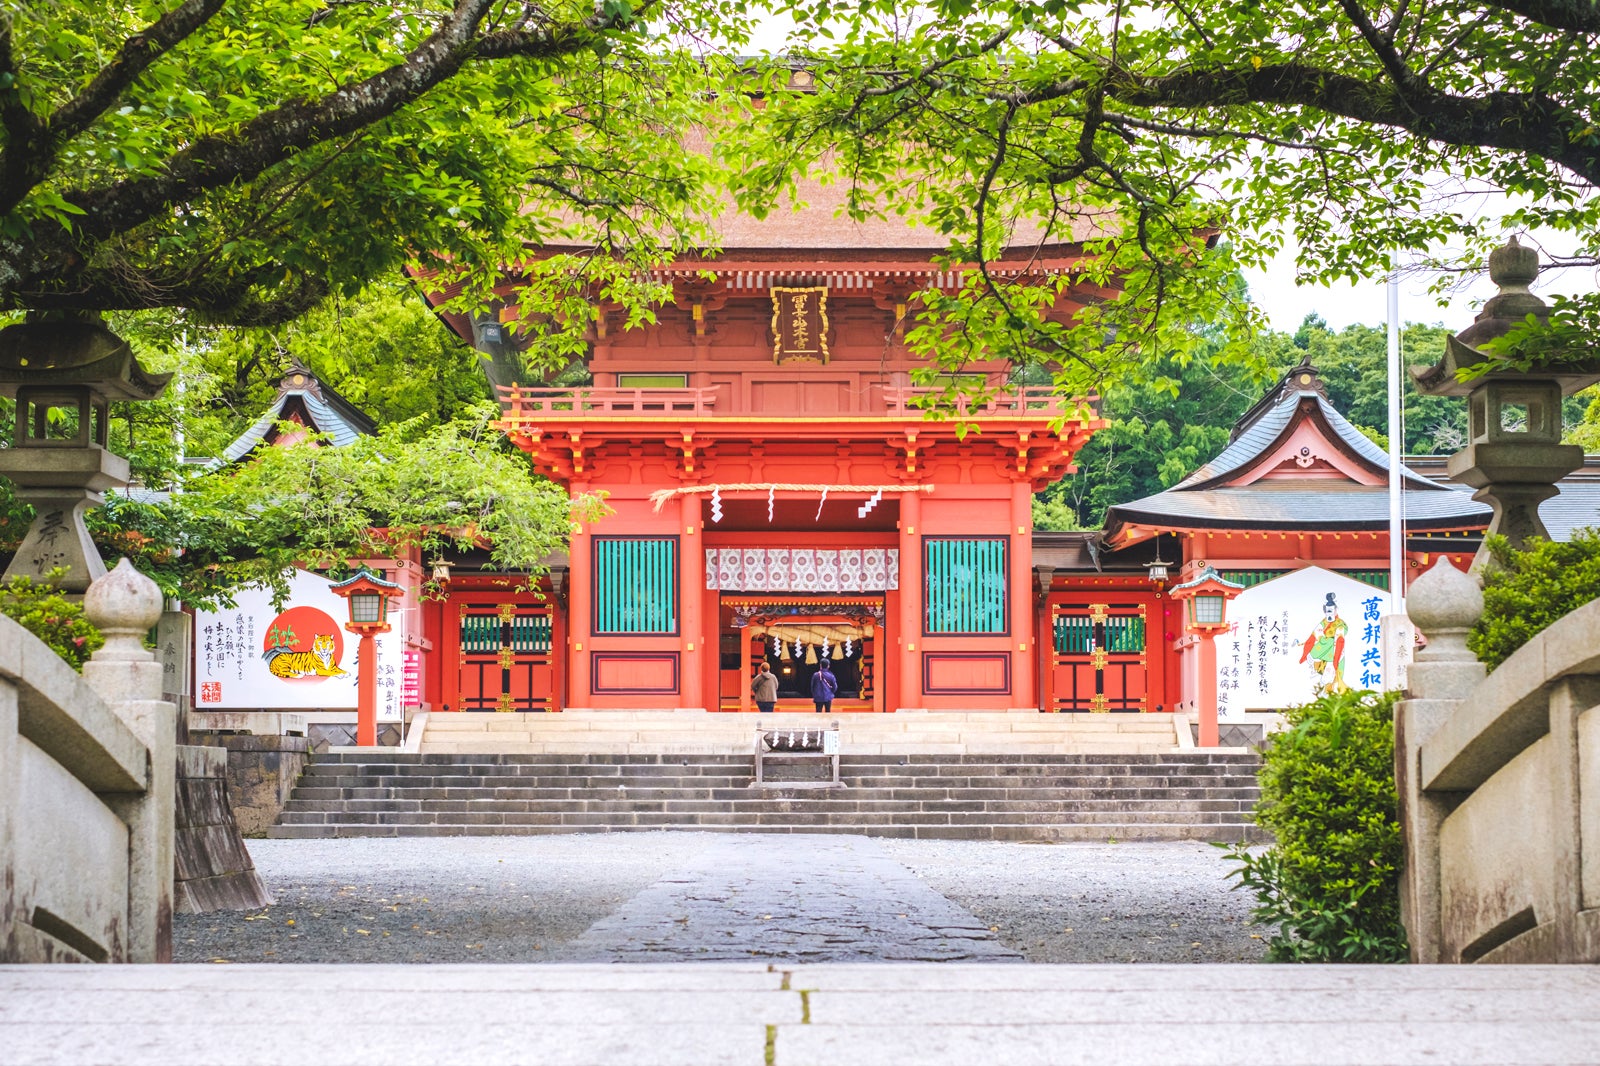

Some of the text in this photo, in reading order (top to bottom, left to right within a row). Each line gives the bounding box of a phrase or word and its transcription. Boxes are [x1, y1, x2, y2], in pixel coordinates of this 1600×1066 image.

[1270, 621, 1281, 654] 人々の
[1360, 596, 1382, 688] 萬邦共和
[1231, 642, 1240, 690] 天下泰平
